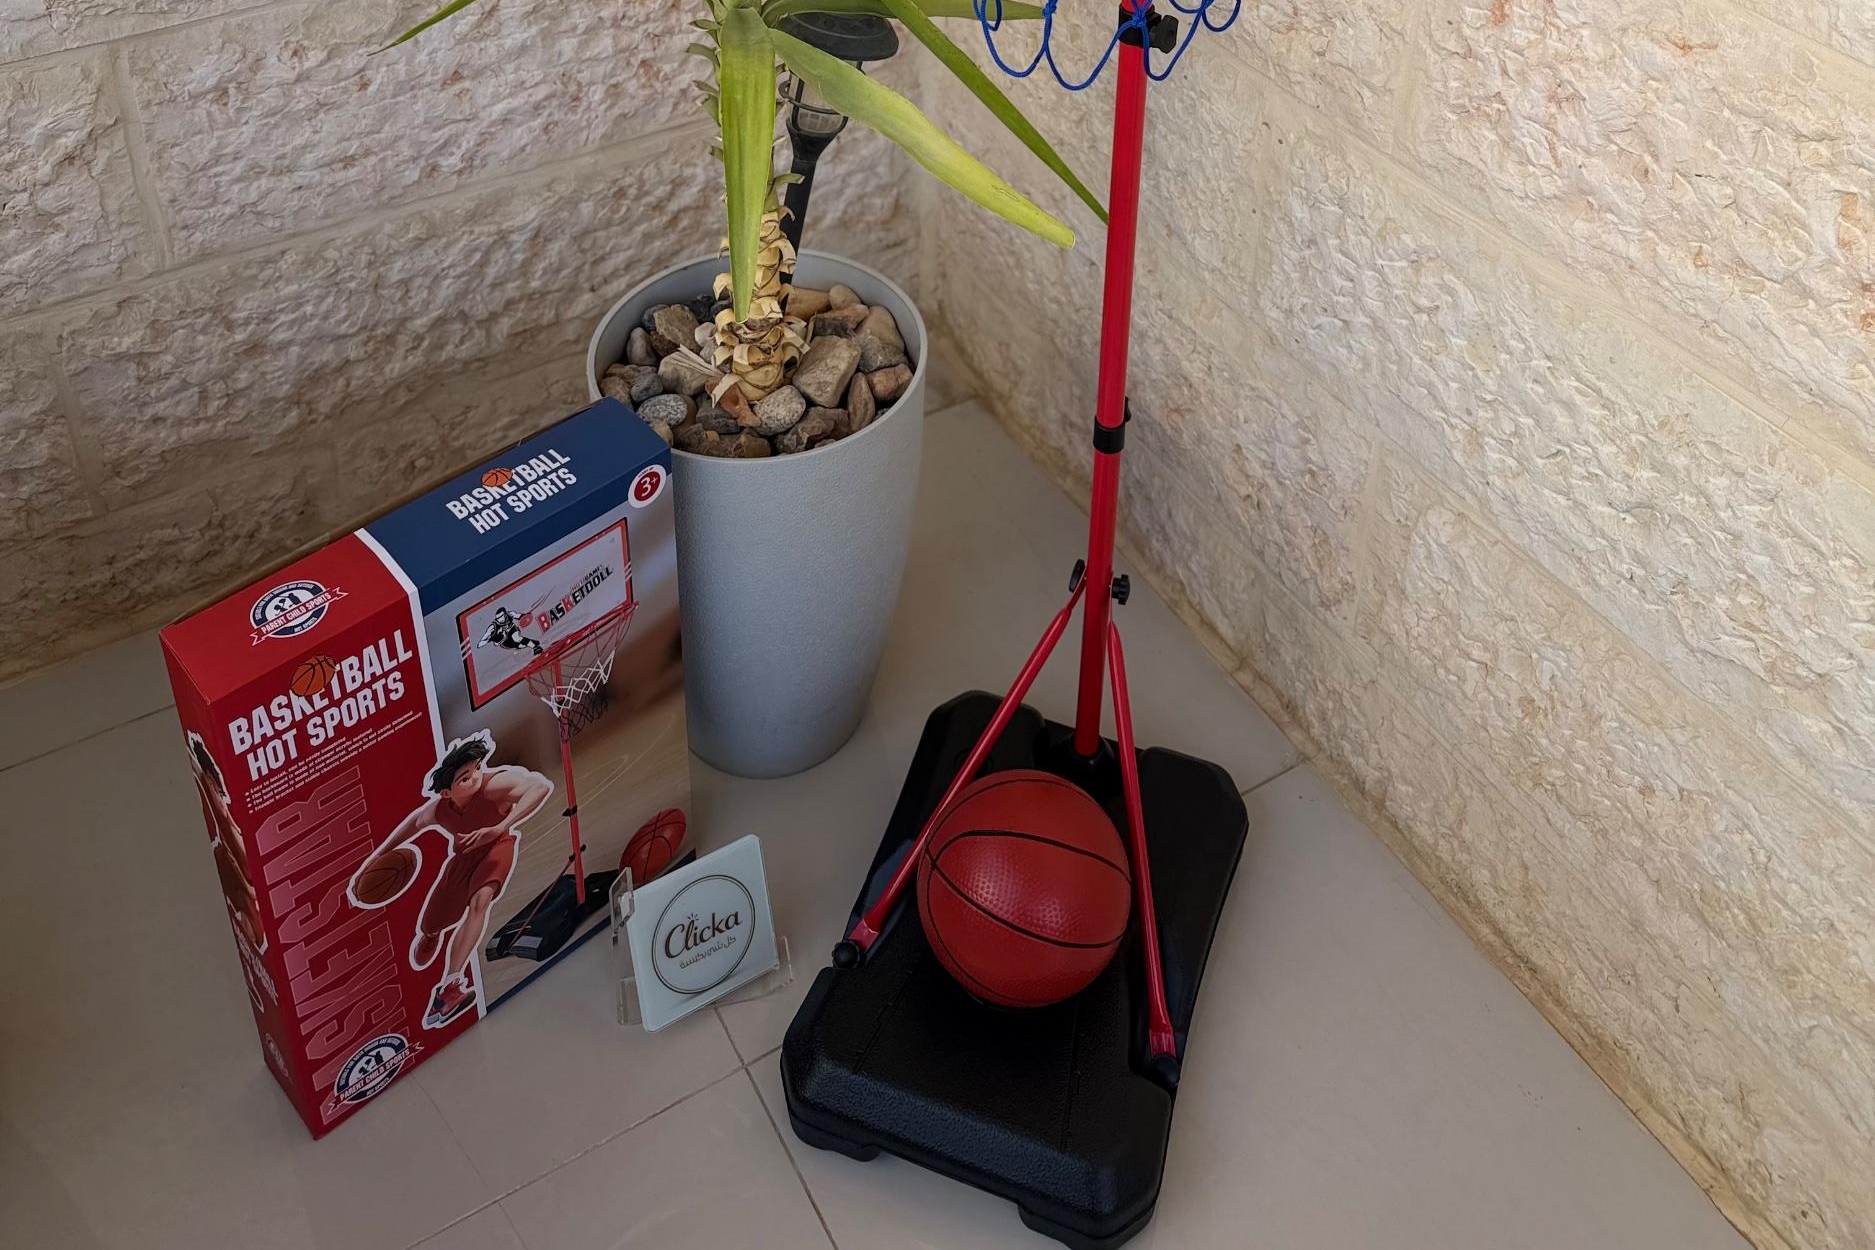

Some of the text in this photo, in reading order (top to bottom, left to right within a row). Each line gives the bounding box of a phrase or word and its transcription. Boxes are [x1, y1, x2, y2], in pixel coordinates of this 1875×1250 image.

[468, 467, 577, 535] HOT SPORTS
[260, 615, 287, 634] PARENT
[285, 607, 307, 621] CHILD
[305, 592, 332, 610] SPORTS
[246, 670, 405, 782] HOT SPORTS
[664, 910, 743, 959] Clicka
[340, 1081, 364, 1101] PARENT
[365, 1067, 385, 1083] CHILD
[385, 1048, 410, 1069] SPORTS
